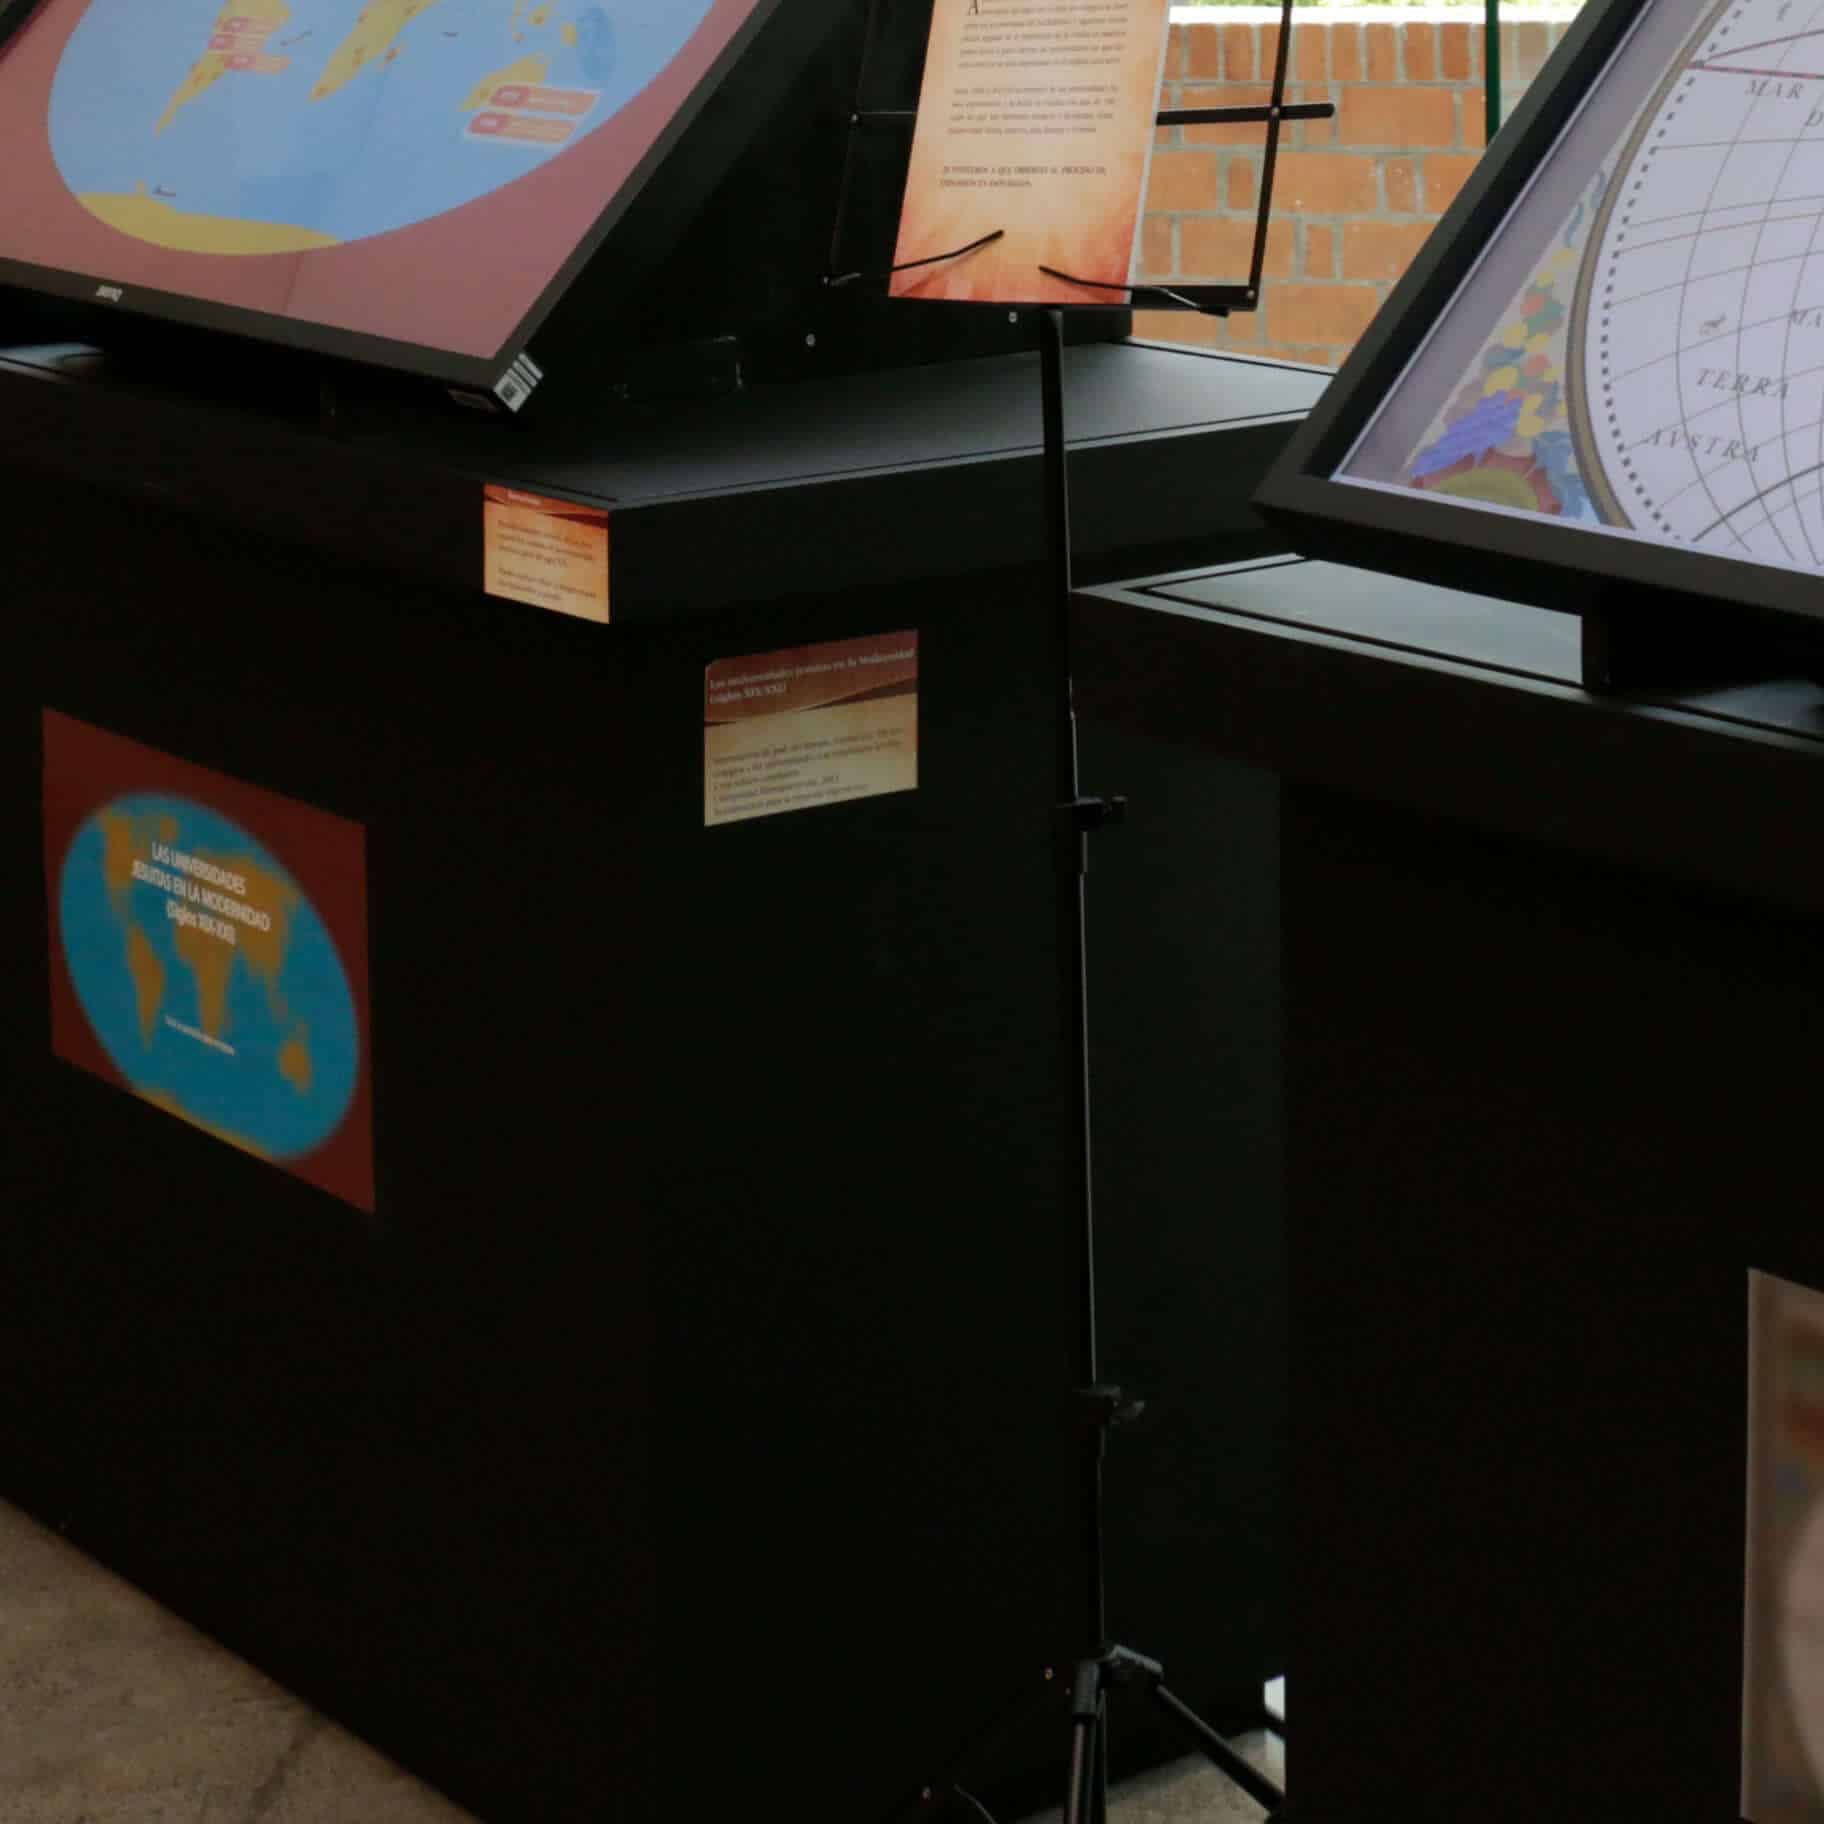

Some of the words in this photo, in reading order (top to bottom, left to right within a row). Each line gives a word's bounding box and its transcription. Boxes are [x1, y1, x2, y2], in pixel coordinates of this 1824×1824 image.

[1745, 78, 1804, 100] MAR
[171, 847, 247, 896] UNIVERSIDADES
[201, 886, 272, 933] MODERNIDAD
